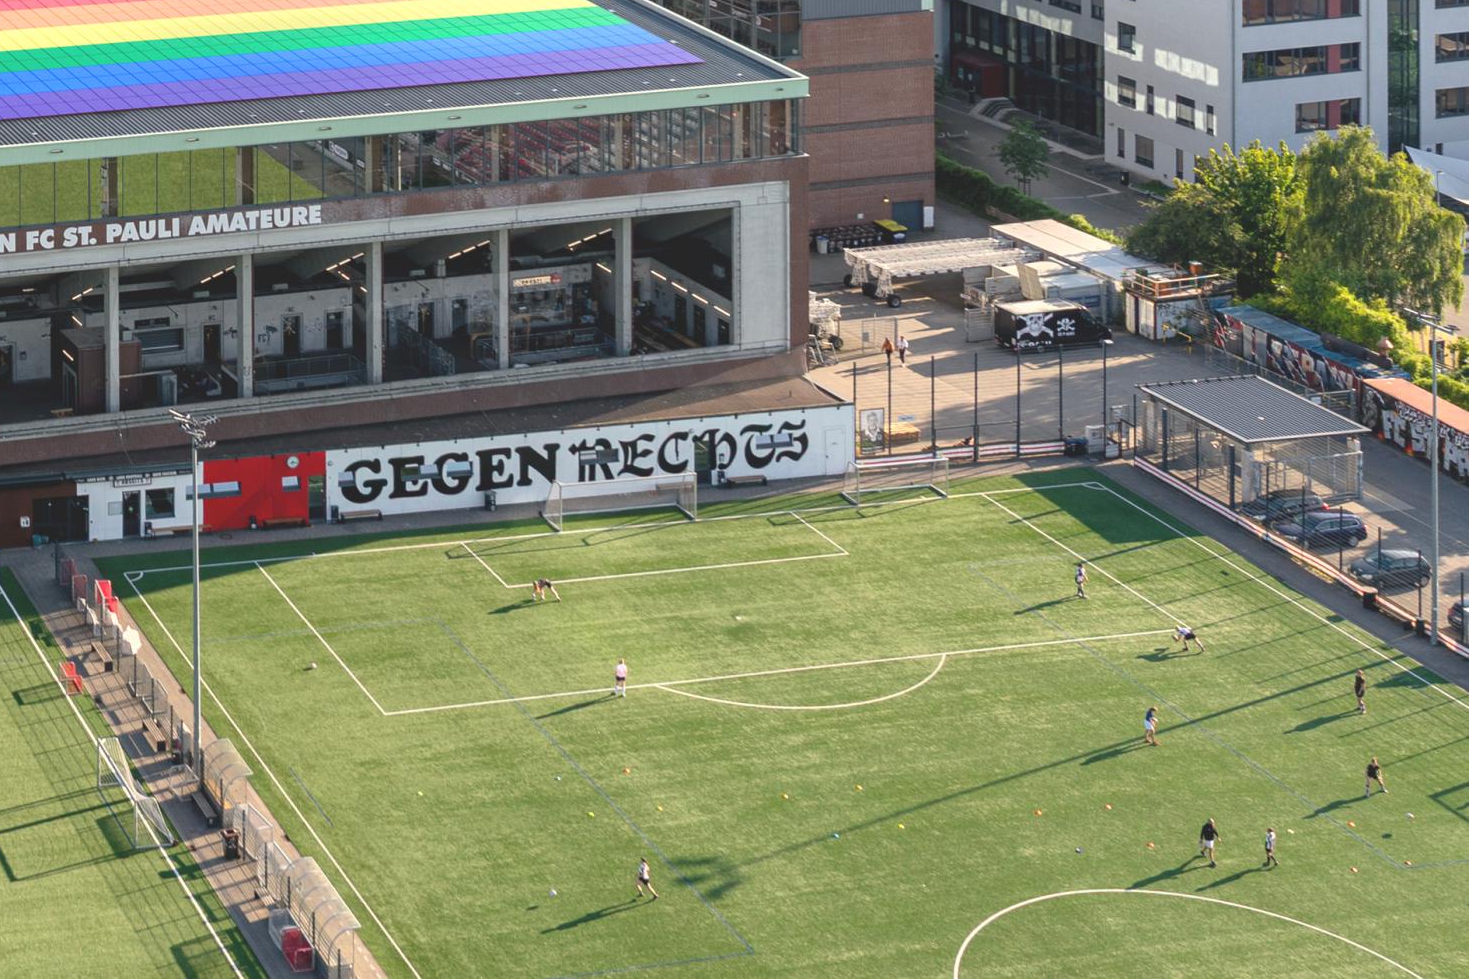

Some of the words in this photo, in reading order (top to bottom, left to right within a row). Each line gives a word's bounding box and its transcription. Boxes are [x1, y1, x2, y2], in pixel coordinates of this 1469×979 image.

[26, 229, 55, 251] FC
[63, 225, 97, 248] ST.
[106, 217, 180, 243] PAULI
[188, 204, 322, 236] AMATEURE
[341, 443, 560, 504] GEGEN
[568, 419, 809, 482] RECHTS
